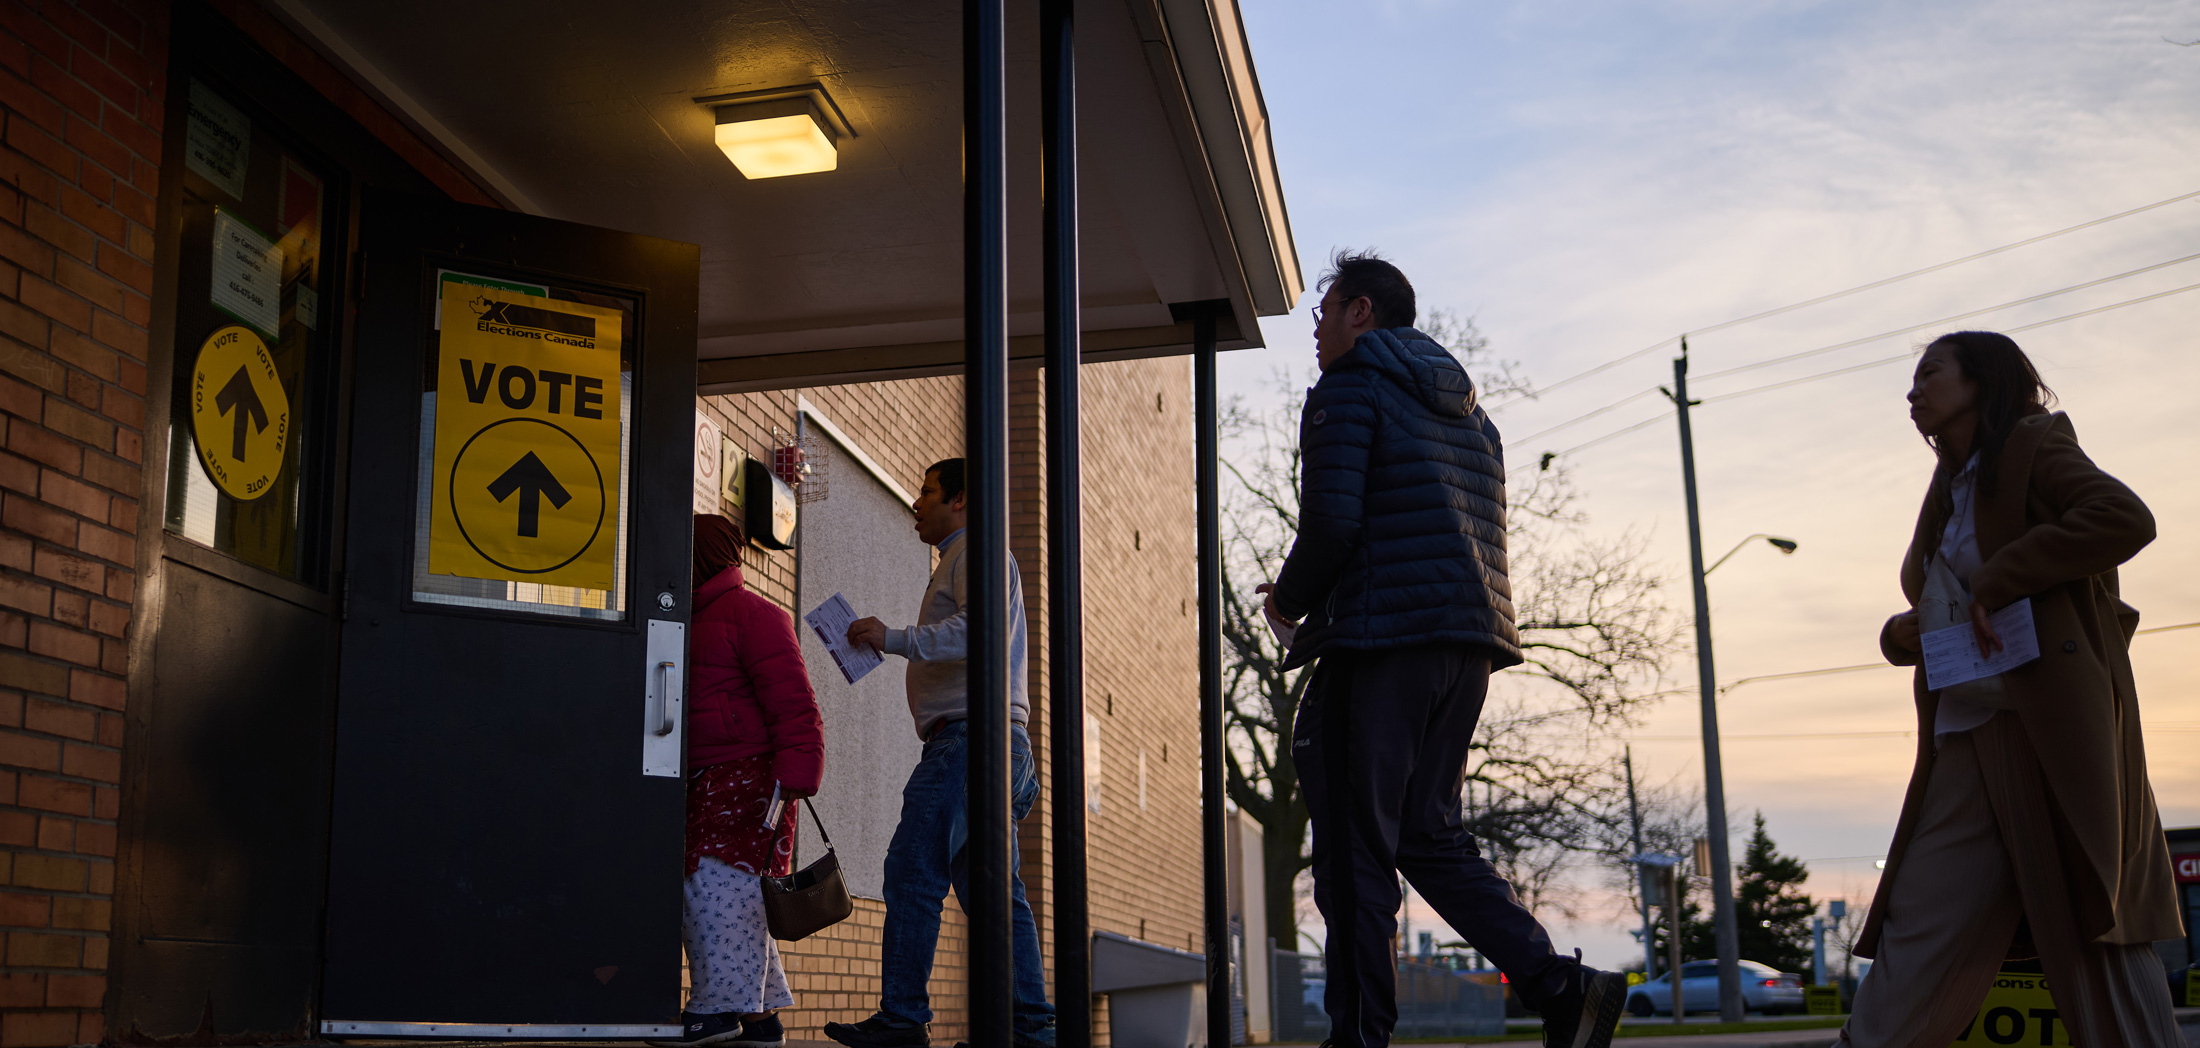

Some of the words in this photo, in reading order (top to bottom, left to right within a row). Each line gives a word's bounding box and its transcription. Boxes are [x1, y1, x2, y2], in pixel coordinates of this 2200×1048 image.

[188, 102, 241, 151] Emergency
[231, 232, 241, 243] For
[241, 239, 268, 263] Caretaking
[236, 251, 261, 272] Deliveries
[213, 332, 239, 350] VOTE
[477, 321, 541, 340] Elections
[544, 333, 595, 350] Canada
[256, 344, 275, 380] VOTE
[196, 371, 206, 414] VOTE
[459, 358, 603, 421] VOTE
[275, 412, 287, 453] VOTE
[205, 447, 228, 484] VOTE
[728, 450, 740, 497] 2
[246, 474, 270, 494] VOTE
[1294, 738, 1310, 748] FILA
[1956, 1006, 2073, 1045] OT
